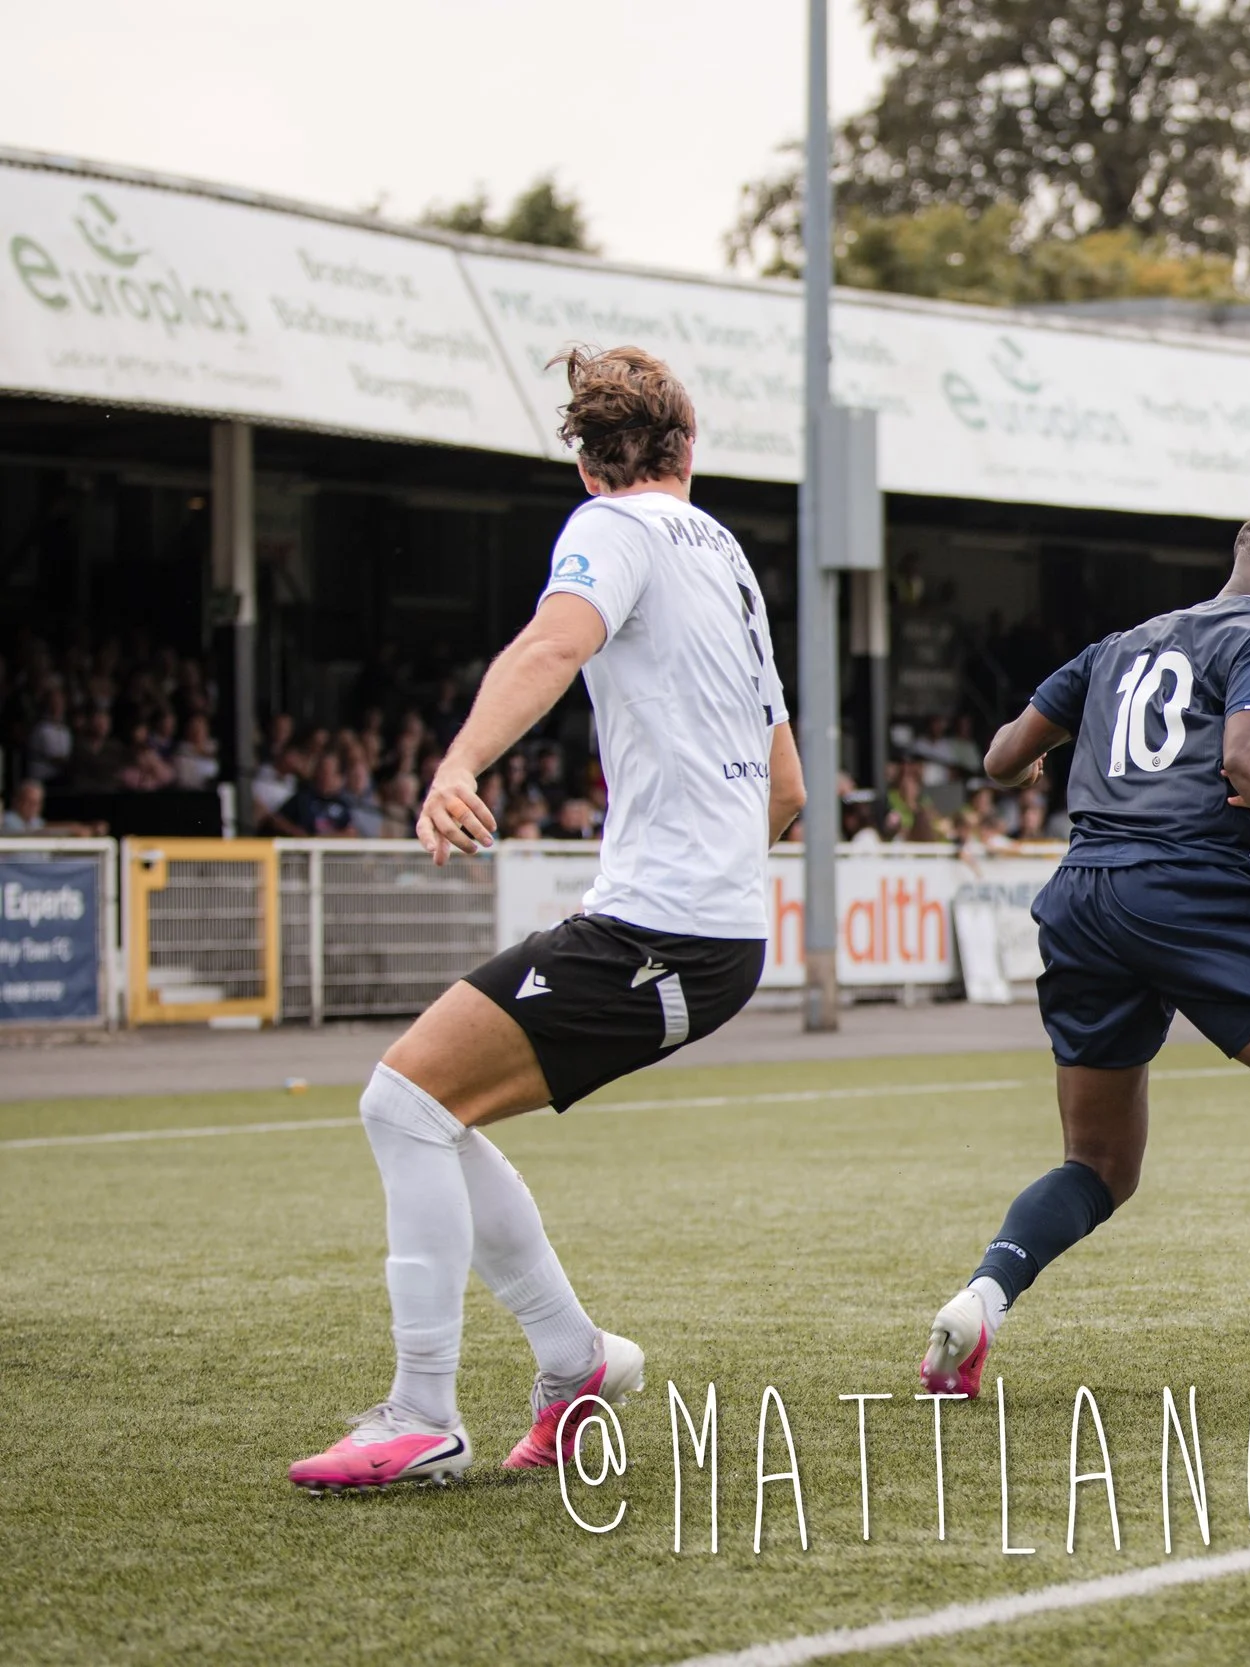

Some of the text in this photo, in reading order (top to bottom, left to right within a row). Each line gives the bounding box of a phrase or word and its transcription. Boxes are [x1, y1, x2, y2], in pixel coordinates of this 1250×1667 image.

[9, 234, 250, 338] europlas
[1107, 651, 1194, 777] 10
[4, 882, 84, 928] Experts
[774, 877, 948, 968] halth
